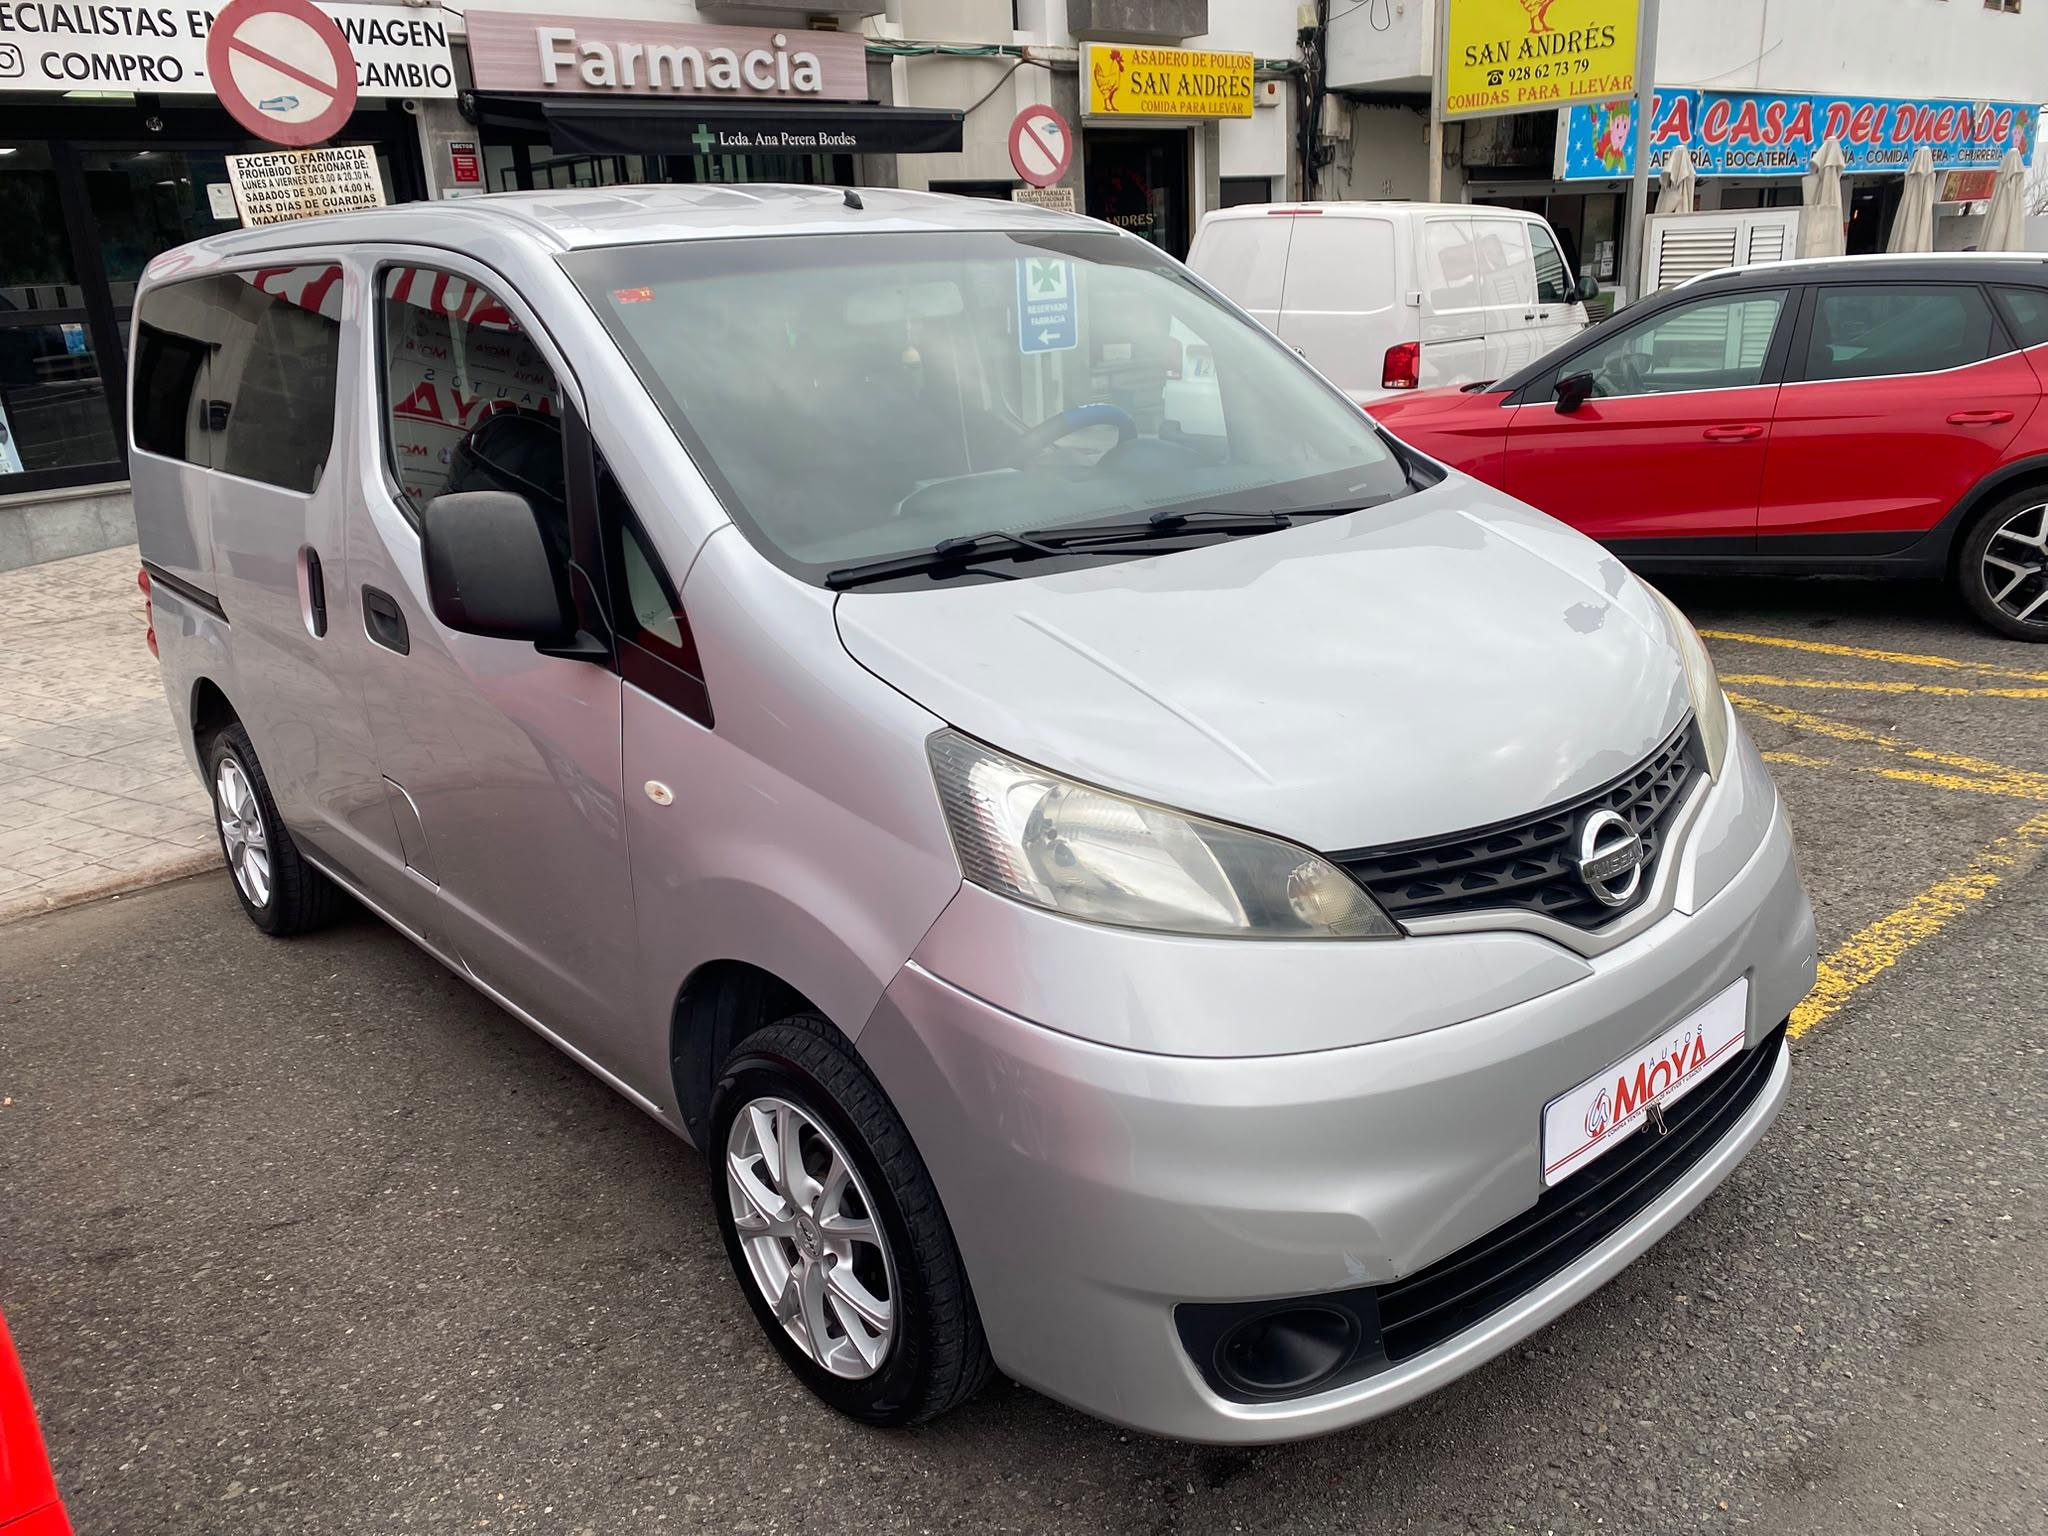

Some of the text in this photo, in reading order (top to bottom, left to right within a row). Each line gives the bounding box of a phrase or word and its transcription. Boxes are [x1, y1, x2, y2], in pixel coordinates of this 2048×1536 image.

[1464, 21, 1616, 68] SAN ANDRÉS
[40, 51, 184, 83] COMPRO
[535, 26, 823, 93] Farmacia
[1131, 49, 1251, 70] ASADERO DE POLLOS
[1508, 58, 1590, 82] 928 62 73 79
[1130, 69, 1251, 98] SAN ANDRÉS
[1447, 74, 1633, 110] COMIDAS PARA LLEVAR
[1141, 100, 1244, 114] COMIDA PARA LLEVAR
[1701, 98, 1813, 146] CASA
[1824, 101, 1889, 145] DEL
[1891, 102, 2013, 145] DUENDE
[719, 131, 857, 146] Lcda. Ana Perera Bordes
[235, 148, 366, 169] EXCEPTO FARMACIA
[1725, 146, 1798, 167] BOCATERÍA
[1866, 149, 1909, 164] COMIDA
[238, 160, 369, 179] PROHIBIDO ESTACIONAR DE:
[241, 179, 267, 191] LUNES
[269, 178, 275, 188] A
[275, 175, 308, 187] VIERNES
[309, 174, 319, 184] DE
[337, 172, 343, 181] A
[293, 188, 306, 198] DE
[308, 186, 327, 196] 9.00
[330, 185, 336, 194] A
[339, 183, 362, 193] 14.00
[364, 182, 374, 191] H.
[305, 199, 319, 209] DE
[322, 193, 377, 207] GUARDIAS
[1649, 1024, 1703, 1069] AUTOS
[1612, 1034, 1707, 1123] MOYA
